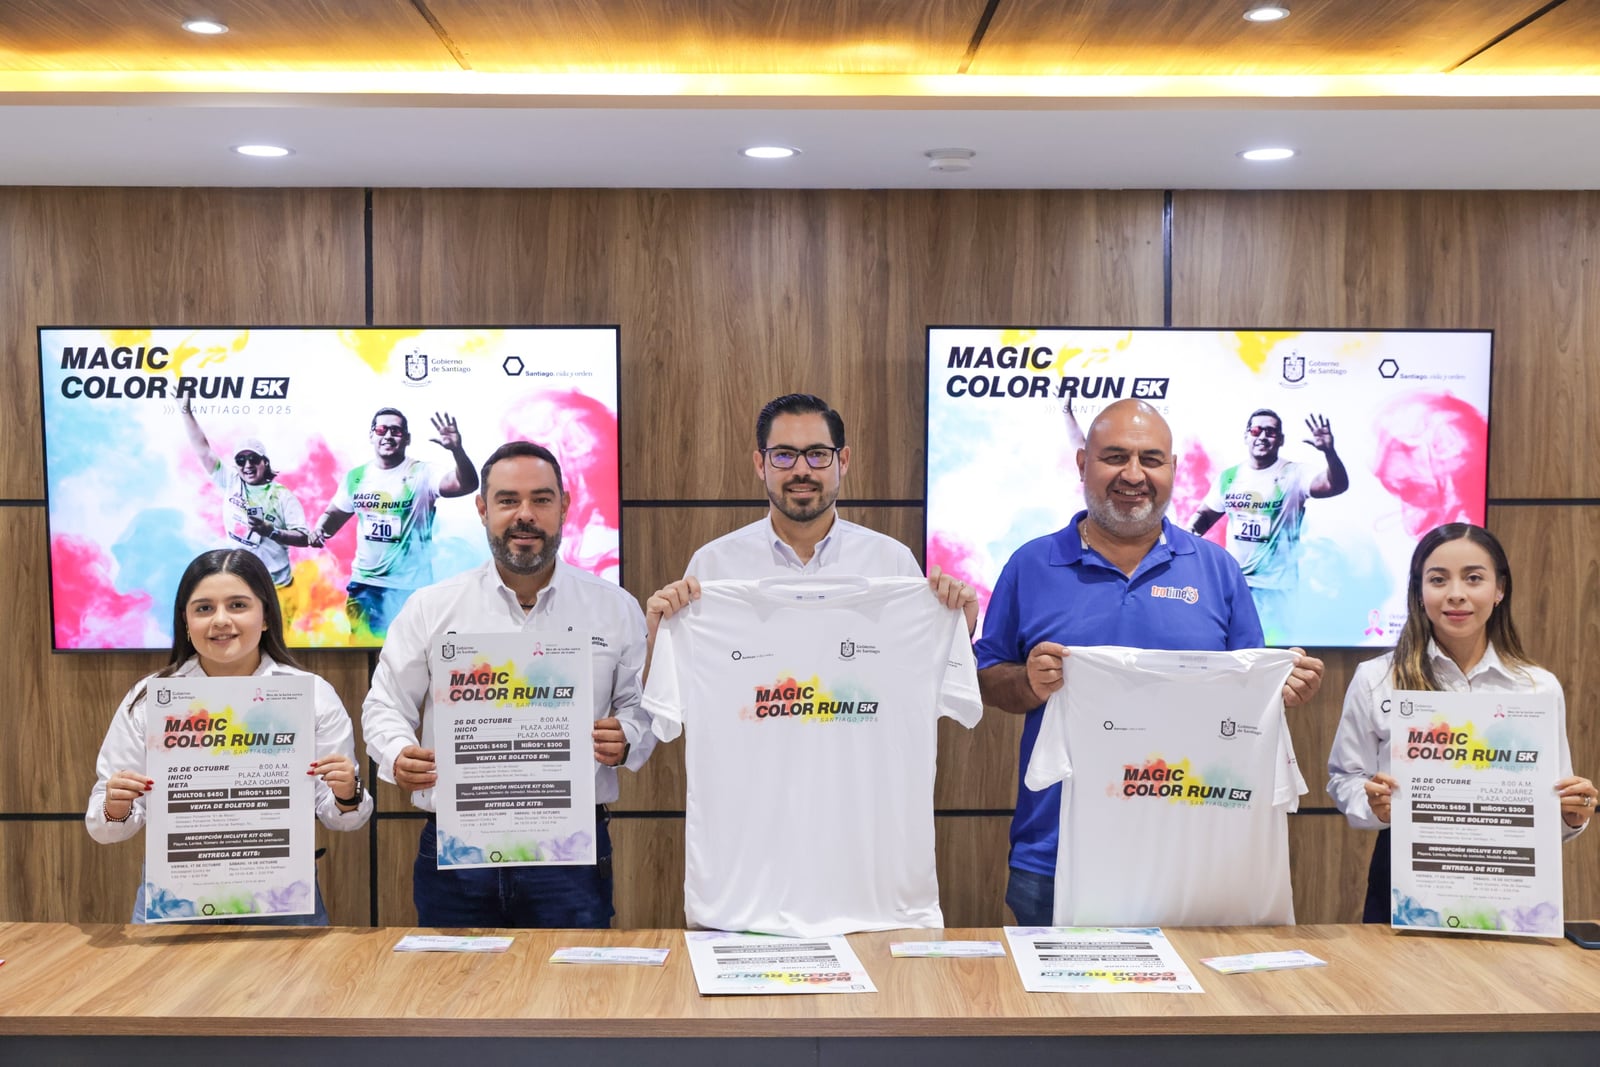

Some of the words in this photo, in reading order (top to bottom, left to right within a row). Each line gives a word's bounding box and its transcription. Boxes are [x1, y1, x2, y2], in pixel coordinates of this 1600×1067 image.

[61, 347, 169, 370] MAGIC
[947, 346, 1053, 369] MAGIC
[441, 366, 472, 374] Santiago
[1318, 367, 1348, 375] Santiago
[61, 376, 168, 399] COLOR
[176, 376, 245, 399] RUN
[255, 379, 286, 396] 5K
[946, 375, 1051, 398] COLOR
[1058, 376, 1125, 399] RUN
[1135, 380, 1165, 397] 5K
[182, 405, 251, 415] SANTIAGO
[258, 405, 292, 415] 2025
[381, 501, 401, 509] RUN
[1252, 501, 1271, 509] RUN
[371, 522, 392, 538] 210
[1241, 522, 1261, 537] 210
[450, 672, 510, 686] MAGIC
[450, 688, 508, 702] COLOR
[513, 687, 550, 700] RUN
[555, 688, 572, 698] 5K
[756, 686, 814, 702] MAGIC
[755, 702, 813, 718] COLOR
[818, 701, 854, 714] RUN
[859, 703, 876, 713] 5K
[164, 718, 228, 732] MAGIC
[164, 735, 226, 748] COLOR
[230, 733, 269, 747] RUN
[275, 734, 293, 744] 5K
[1408, 731, 1468, 745] MAGIC
[1407, 747, 1467, 761] COLOR
[1472, 749, 1511, 762] RUN
[1518, 752, 1536, 762] 5K
[263, 770, 289, 778] JUÁREZ
[1123, 768, 1184, 781] MAGIC
[172, 791, 206, 799] ADULTOS:
[1123, 784, 1183, 797] COLOR
[1187, 785, 1226, 799] RUN
[1231, 790, 1249, 801] 5K
[198, 851, 230, 859] ENTREGA
[1441, 864, 1474, 872] ENTREGA
